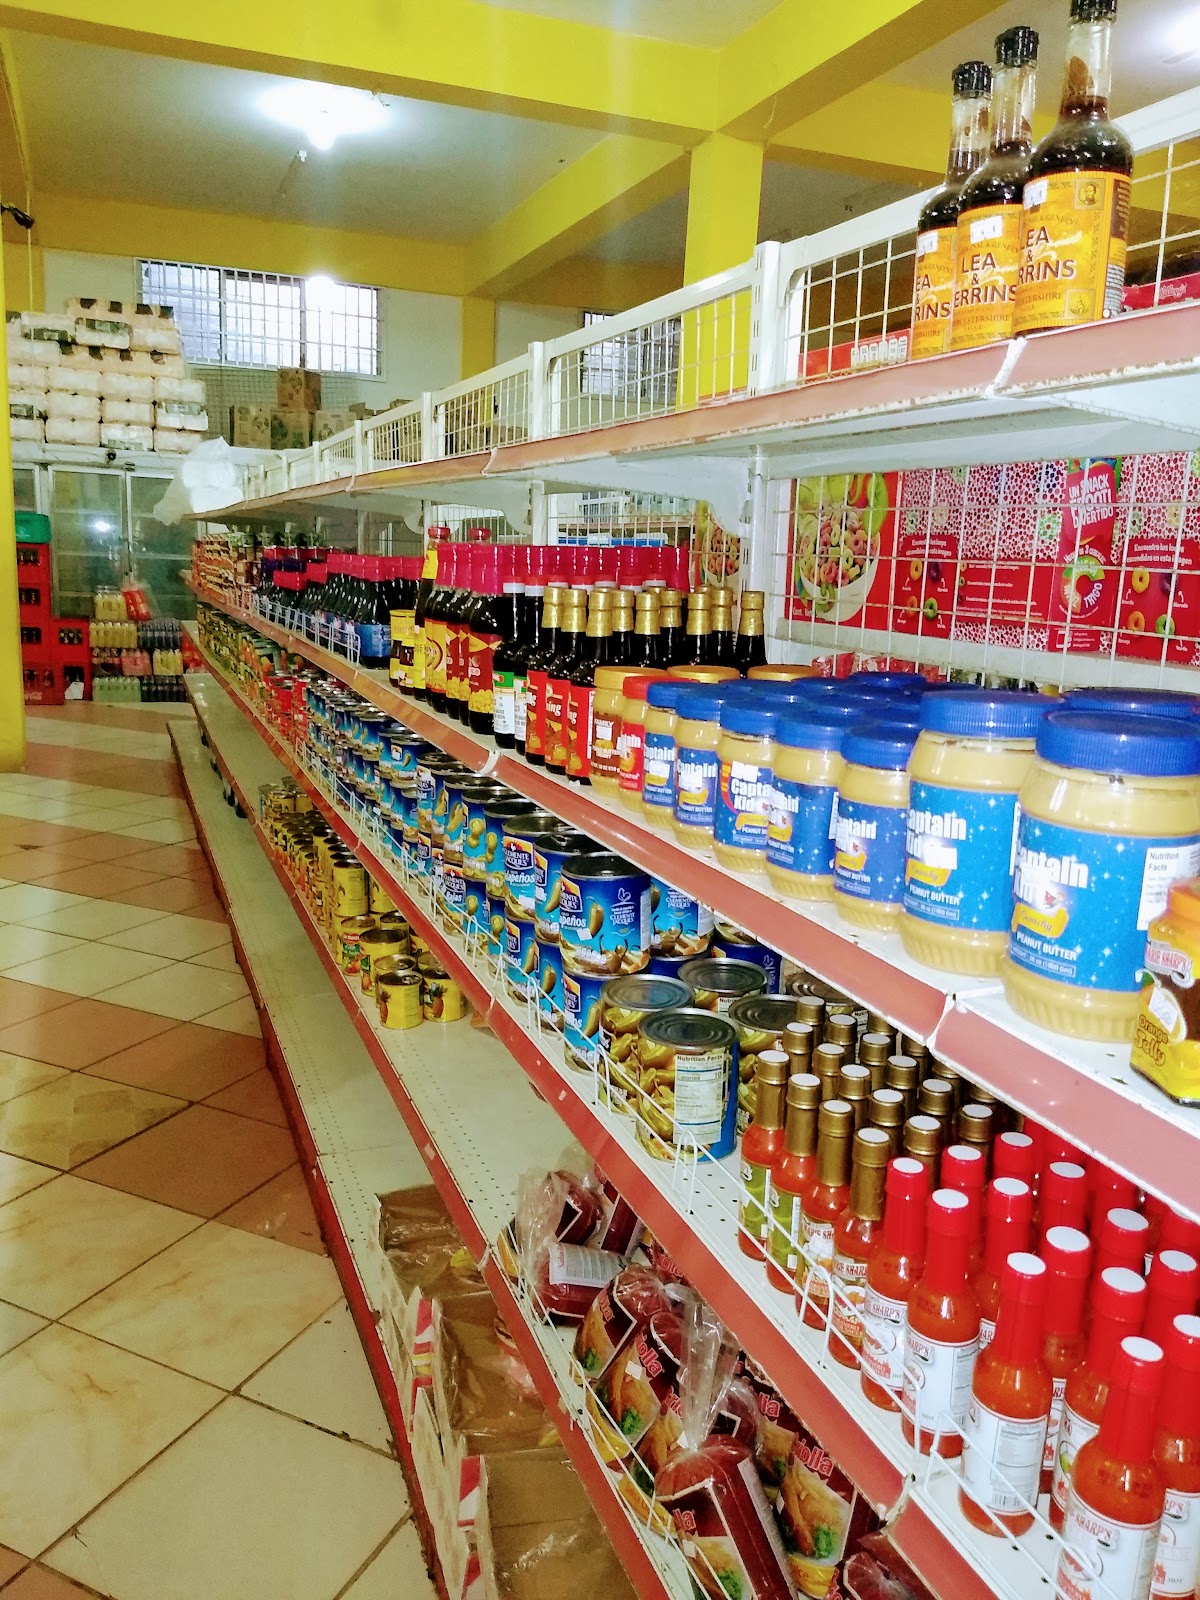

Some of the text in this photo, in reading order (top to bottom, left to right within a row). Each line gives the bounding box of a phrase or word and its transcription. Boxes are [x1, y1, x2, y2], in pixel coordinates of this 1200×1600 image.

[962, 252, 997, 274] LEA
[1026, 249, 1034, 263] &
[971, 273, 980, 286] &
[1069, 485, 1080, 499] UN
[1084, 544, 1090, 555] 3
[1083, 582, 1103, 609] TRIGO
[733, 795, 756, 813] Kid
[506, 856, 528, 868] ACQUES
[1149, 851, 1180, 861] Nutrition
[1148, 863, 1168, 872] Facts
[504, 869, 535, 886] lapeños
[909, 884, 961, 907] PEANUT BUTTER
[1016, 930, 1078, 962] PEANUT BUTTER
[1139, 1013, 1169, 1045] Orange
[1134, 1028, 1166, 1067] Jelly
[872, 1303, 902, 1320] SHARP'S
